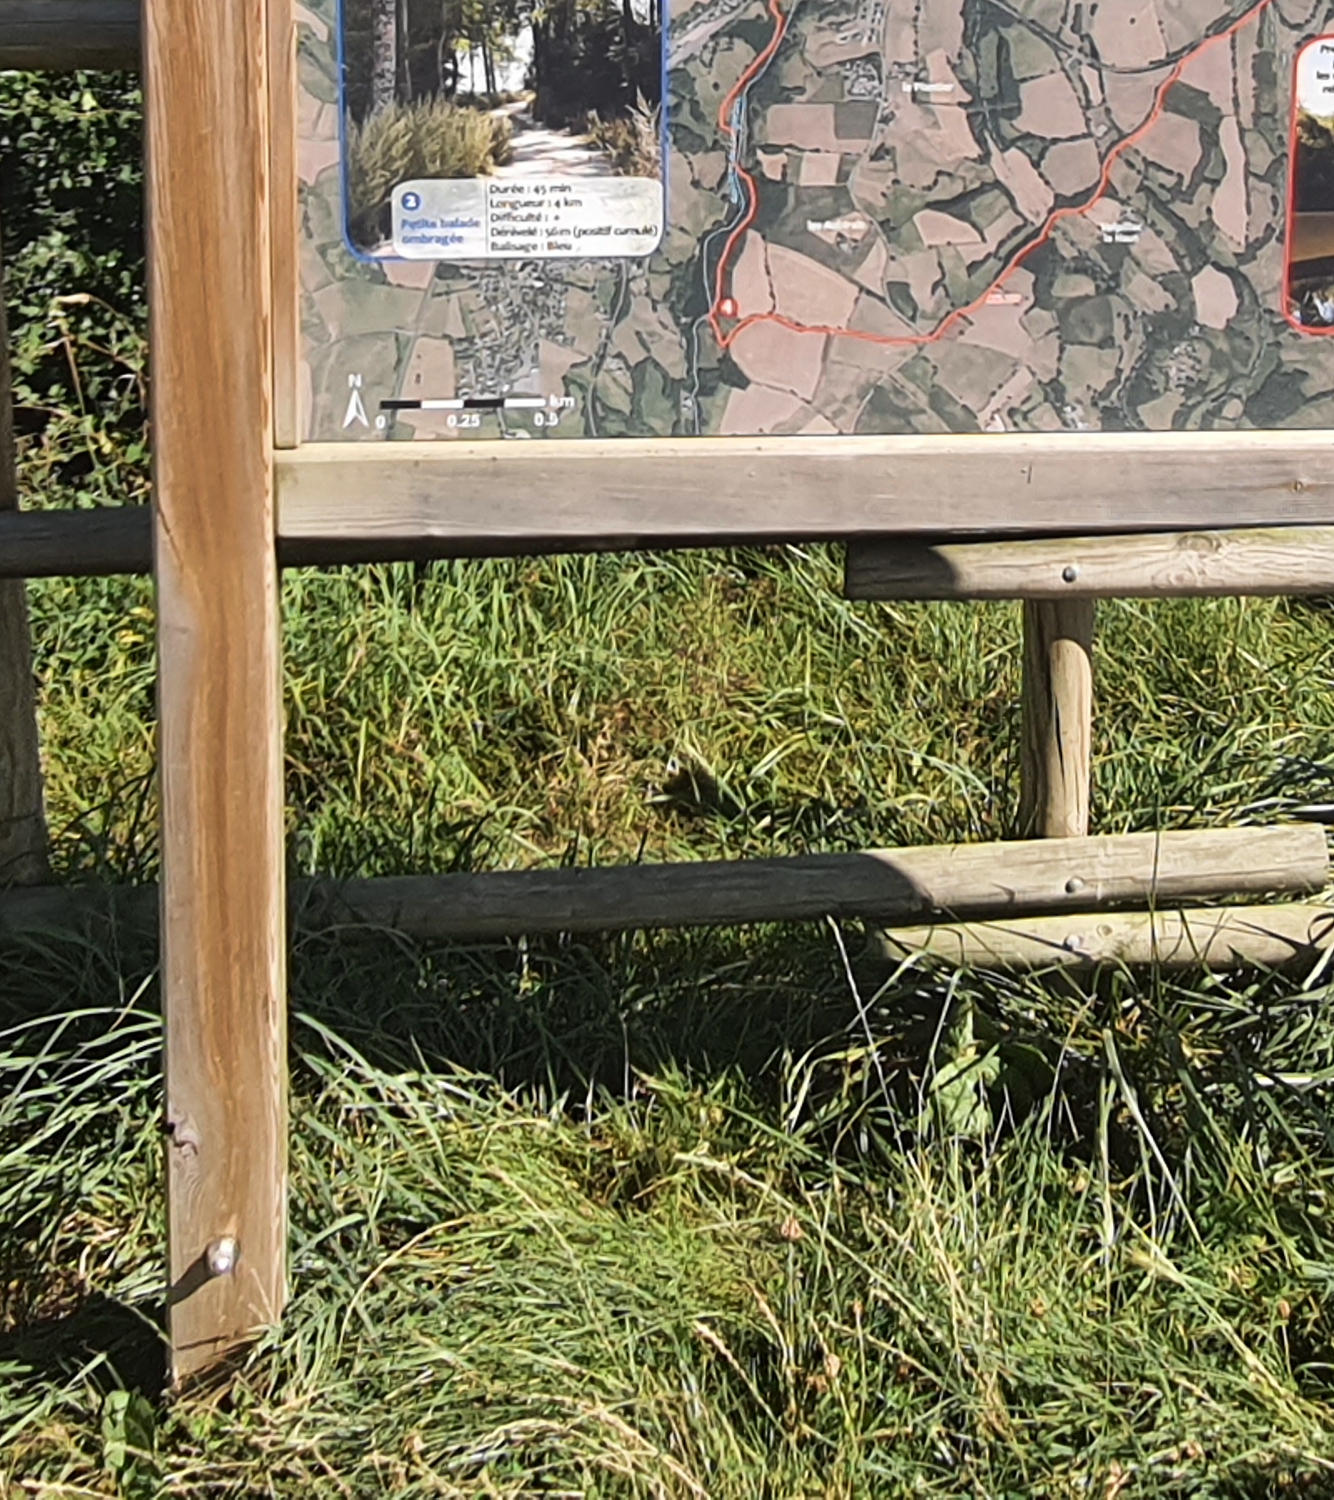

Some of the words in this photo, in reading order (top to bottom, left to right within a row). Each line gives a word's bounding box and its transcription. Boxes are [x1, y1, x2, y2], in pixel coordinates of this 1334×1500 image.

[490, 184, 524, 194] Durée
[550, 184, 571, 193] min
[490, 199, 544, 210] Longueur
[564, 197, 582, 207] km
[491, 213, 542, 223] Difficulté
[573, 225, 611, 239] (positif
[614, 225, 658, 239] cumulé)
[348, 374, 361, 387] N
[549, 395, 575, 407] km
[375, 416, 386, 429] 0
[447, 415, 480, 428] 0.25
